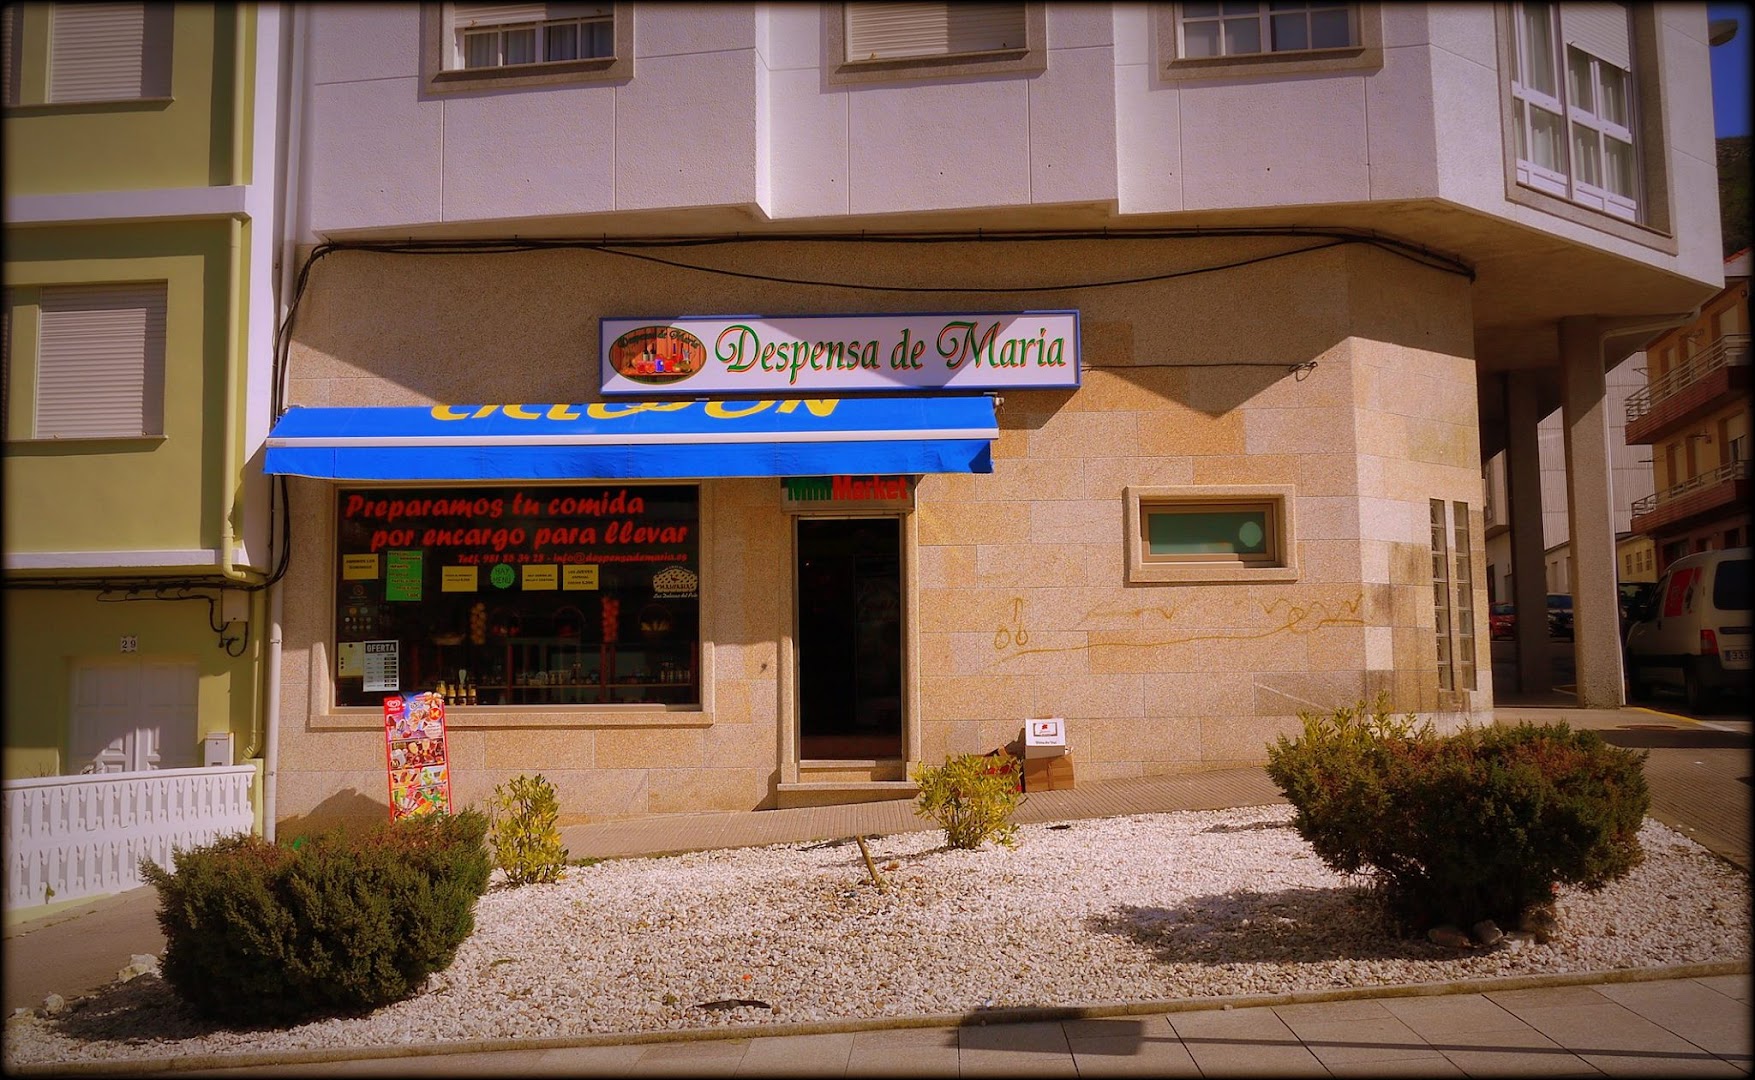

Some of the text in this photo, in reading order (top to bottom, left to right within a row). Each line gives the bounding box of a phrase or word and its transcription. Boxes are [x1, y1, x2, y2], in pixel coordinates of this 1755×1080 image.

[714, 323, 881, 386] Despensa
[889, 328, 926, 371] de
[345, 489, 645, 523] Preparamos tu comida
[370, 520, 688, 553] por encargo para llevar
[494, 567, 510, 575] HAY
[121, 639, 137, 649] 29
[366, 643, 396, 653] OFERTA
